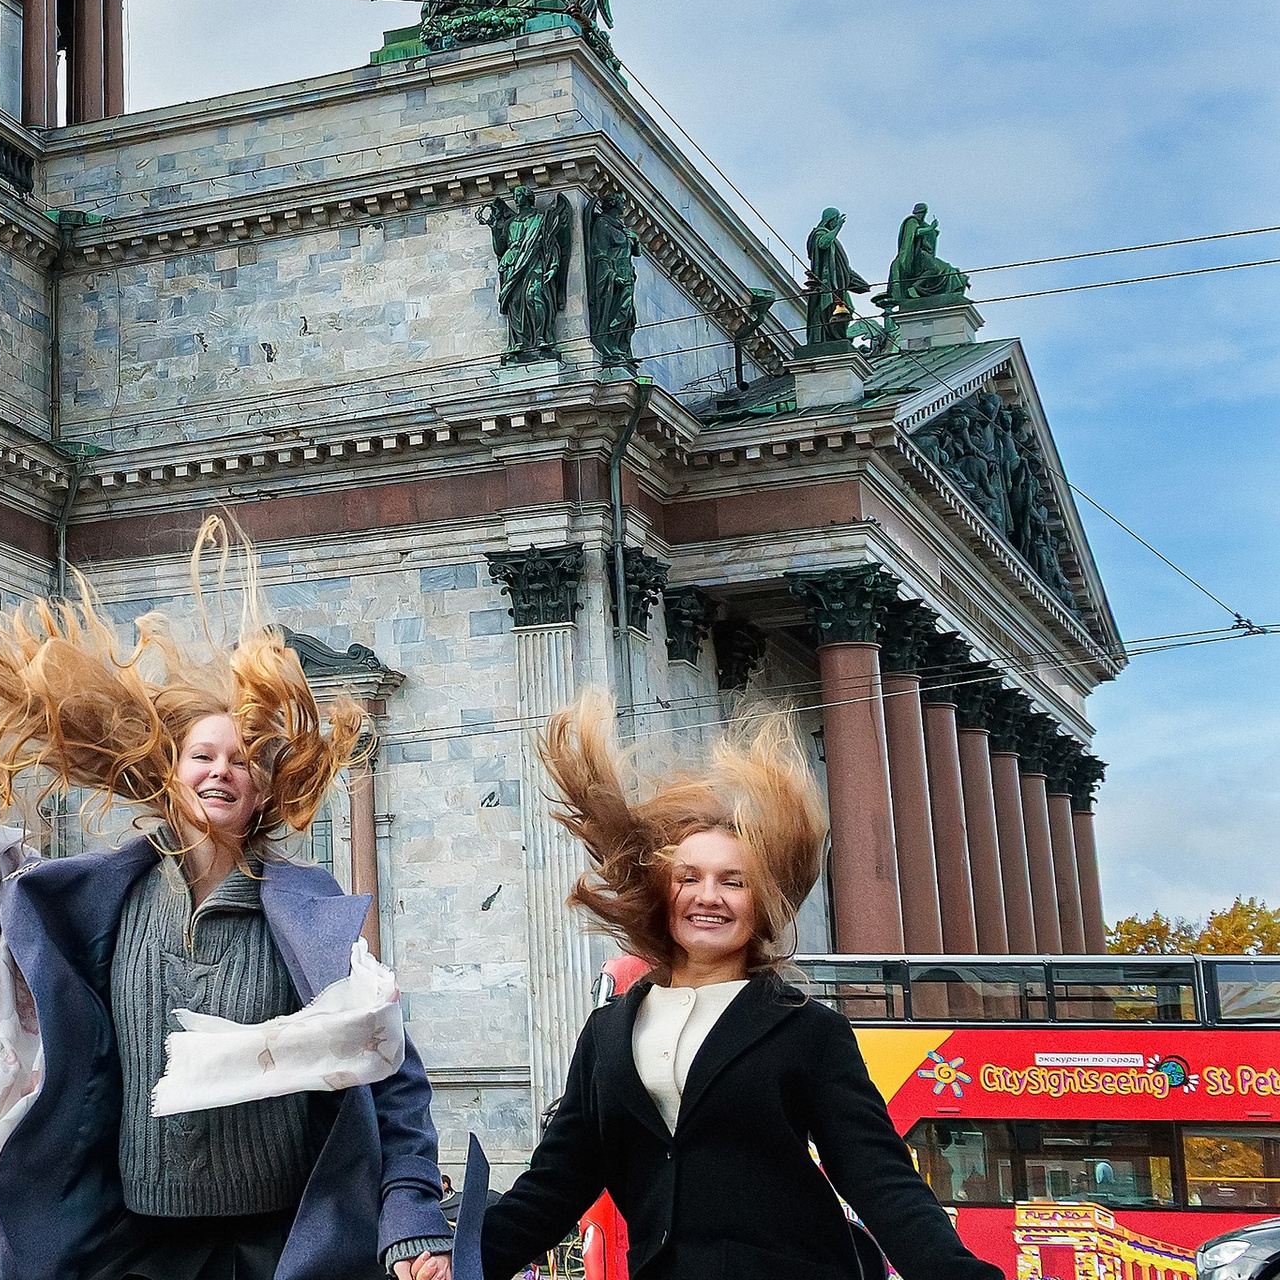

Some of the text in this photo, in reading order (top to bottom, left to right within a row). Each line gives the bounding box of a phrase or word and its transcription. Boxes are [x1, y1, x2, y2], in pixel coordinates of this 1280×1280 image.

[1037, 1056, 1142, 1065] экскурсии по городу
[1203, 1066, 1236, 1096] St
